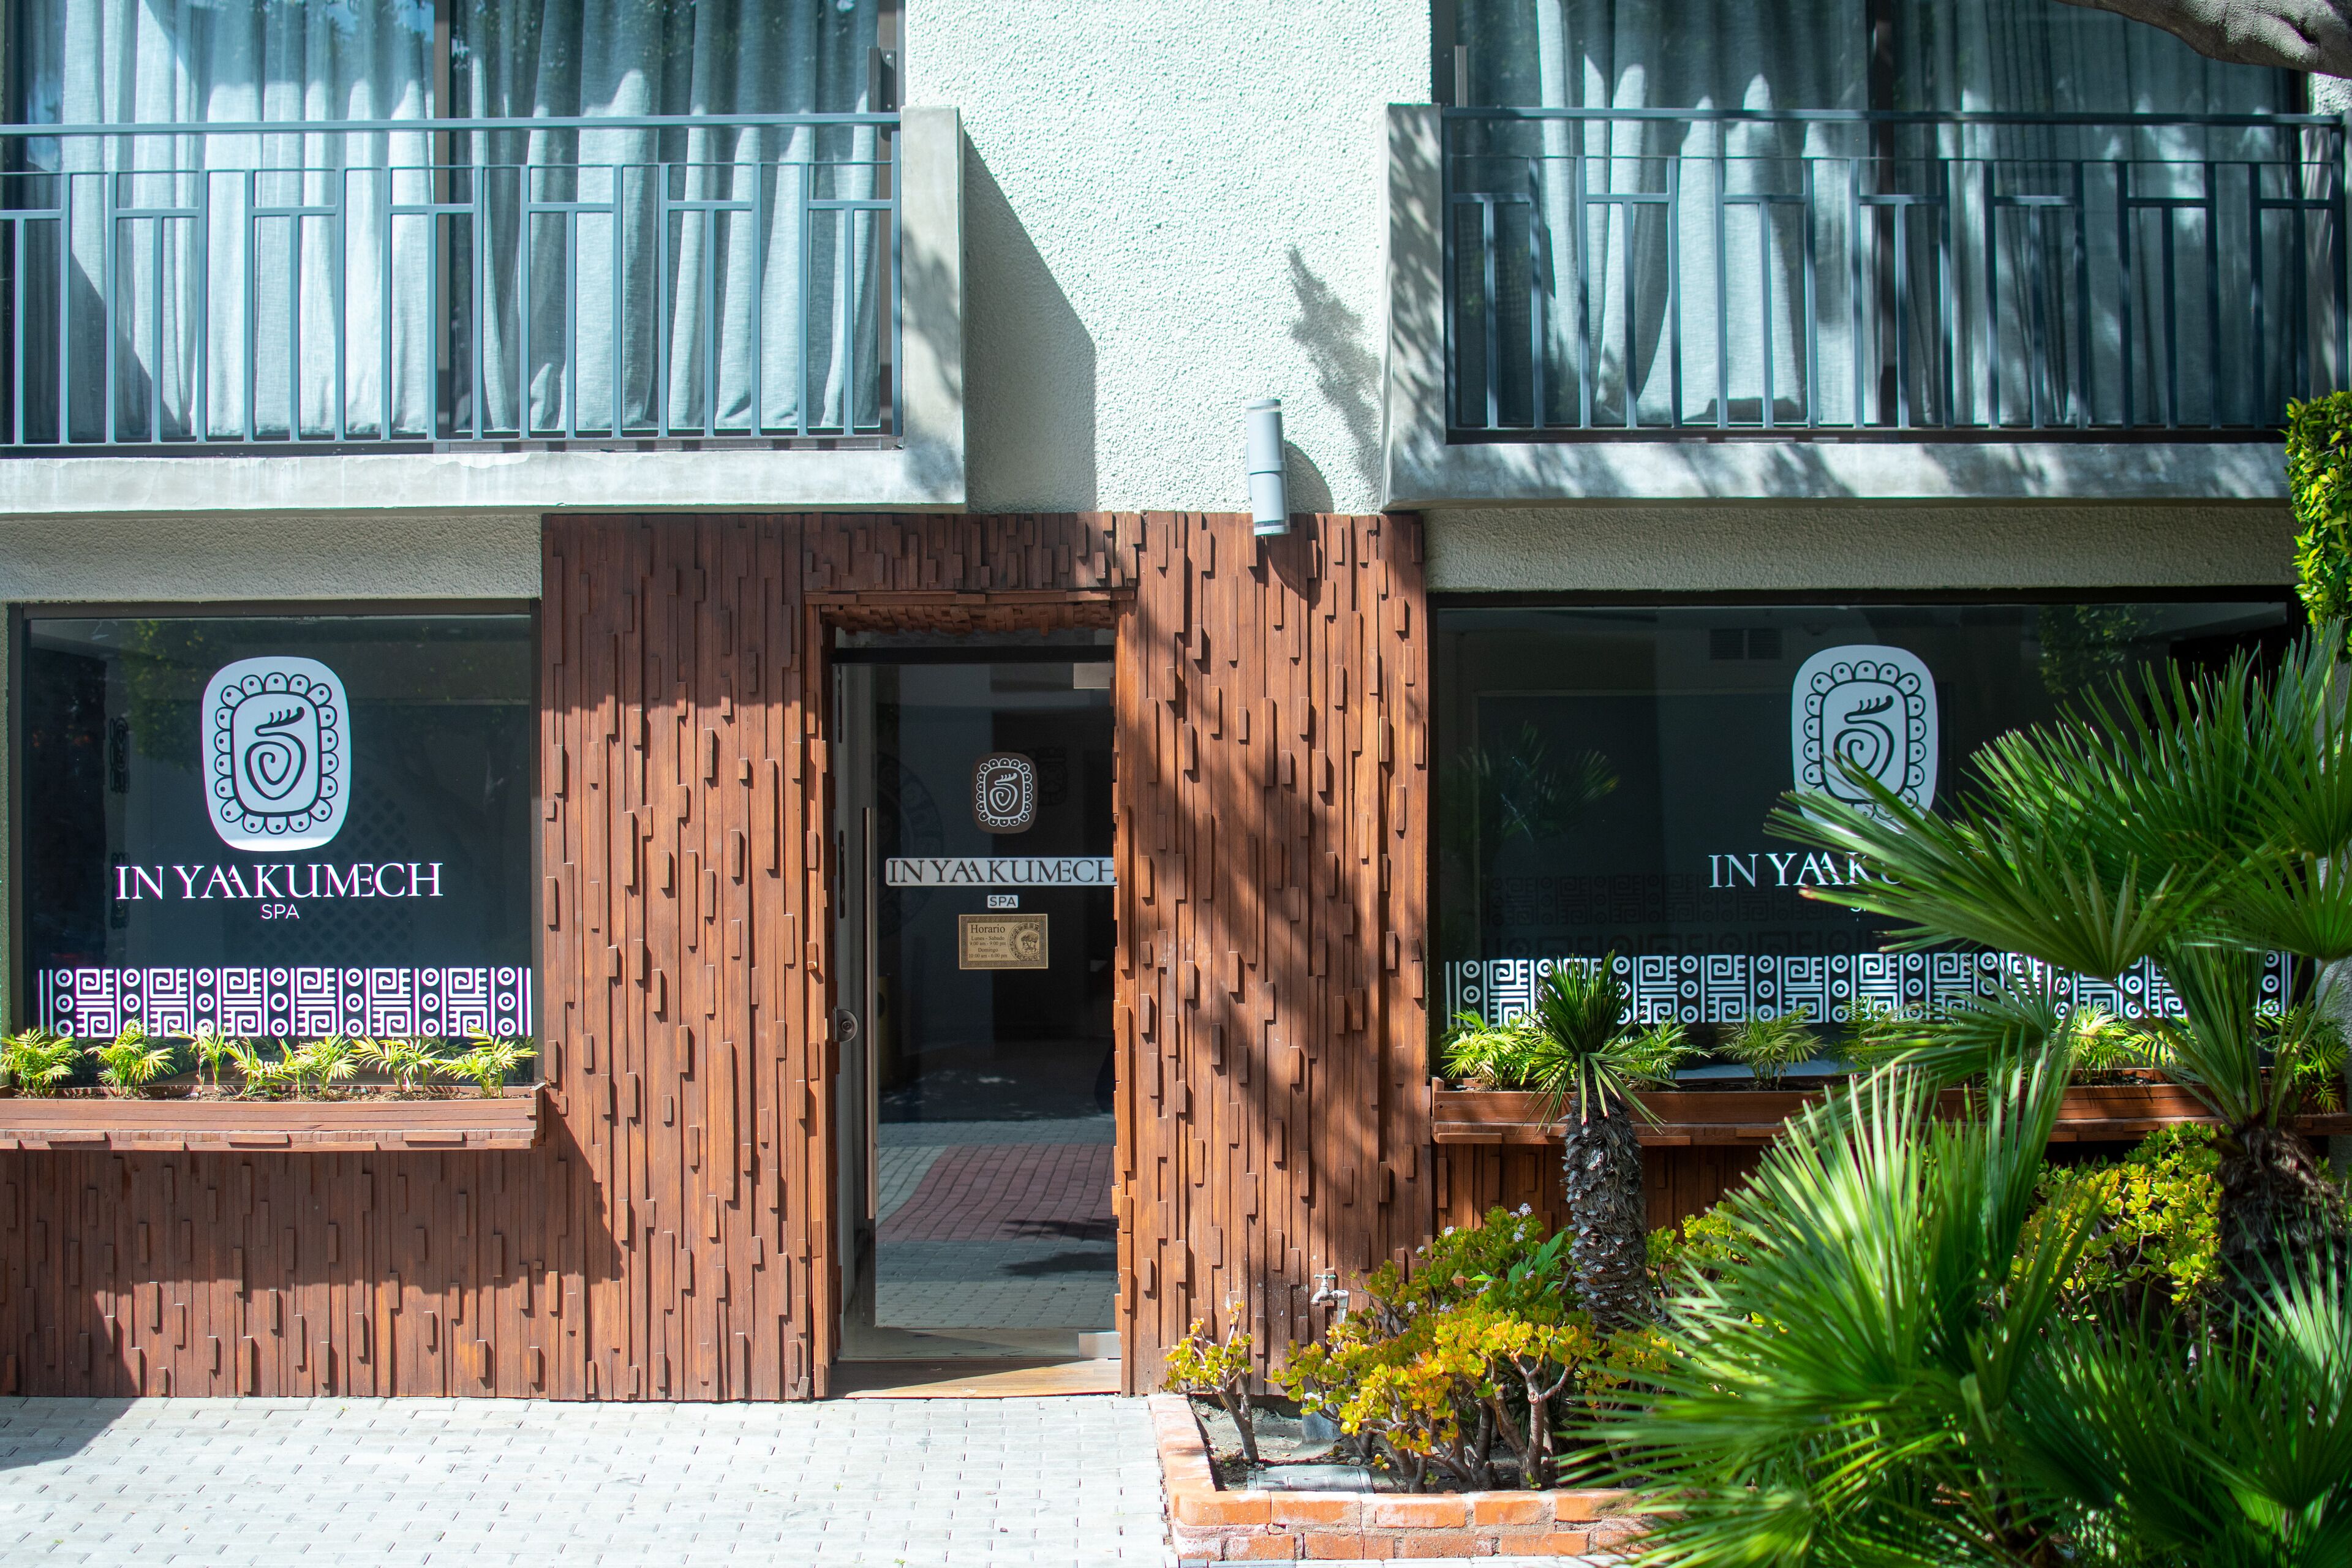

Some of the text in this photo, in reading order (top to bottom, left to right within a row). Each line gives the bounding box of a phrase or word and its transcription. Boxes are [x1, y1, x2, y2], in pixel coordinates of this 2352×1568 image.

[116, 862, 444, 900] IN YAAKUMECH
[889, 860, 924, 883] IN
[1708, 854, 1758, 888] IN
[260, 903, 300, 920] SPA
[989, 896, 1016, 907] SPA
[970, 924, 1006, 933] Horario
